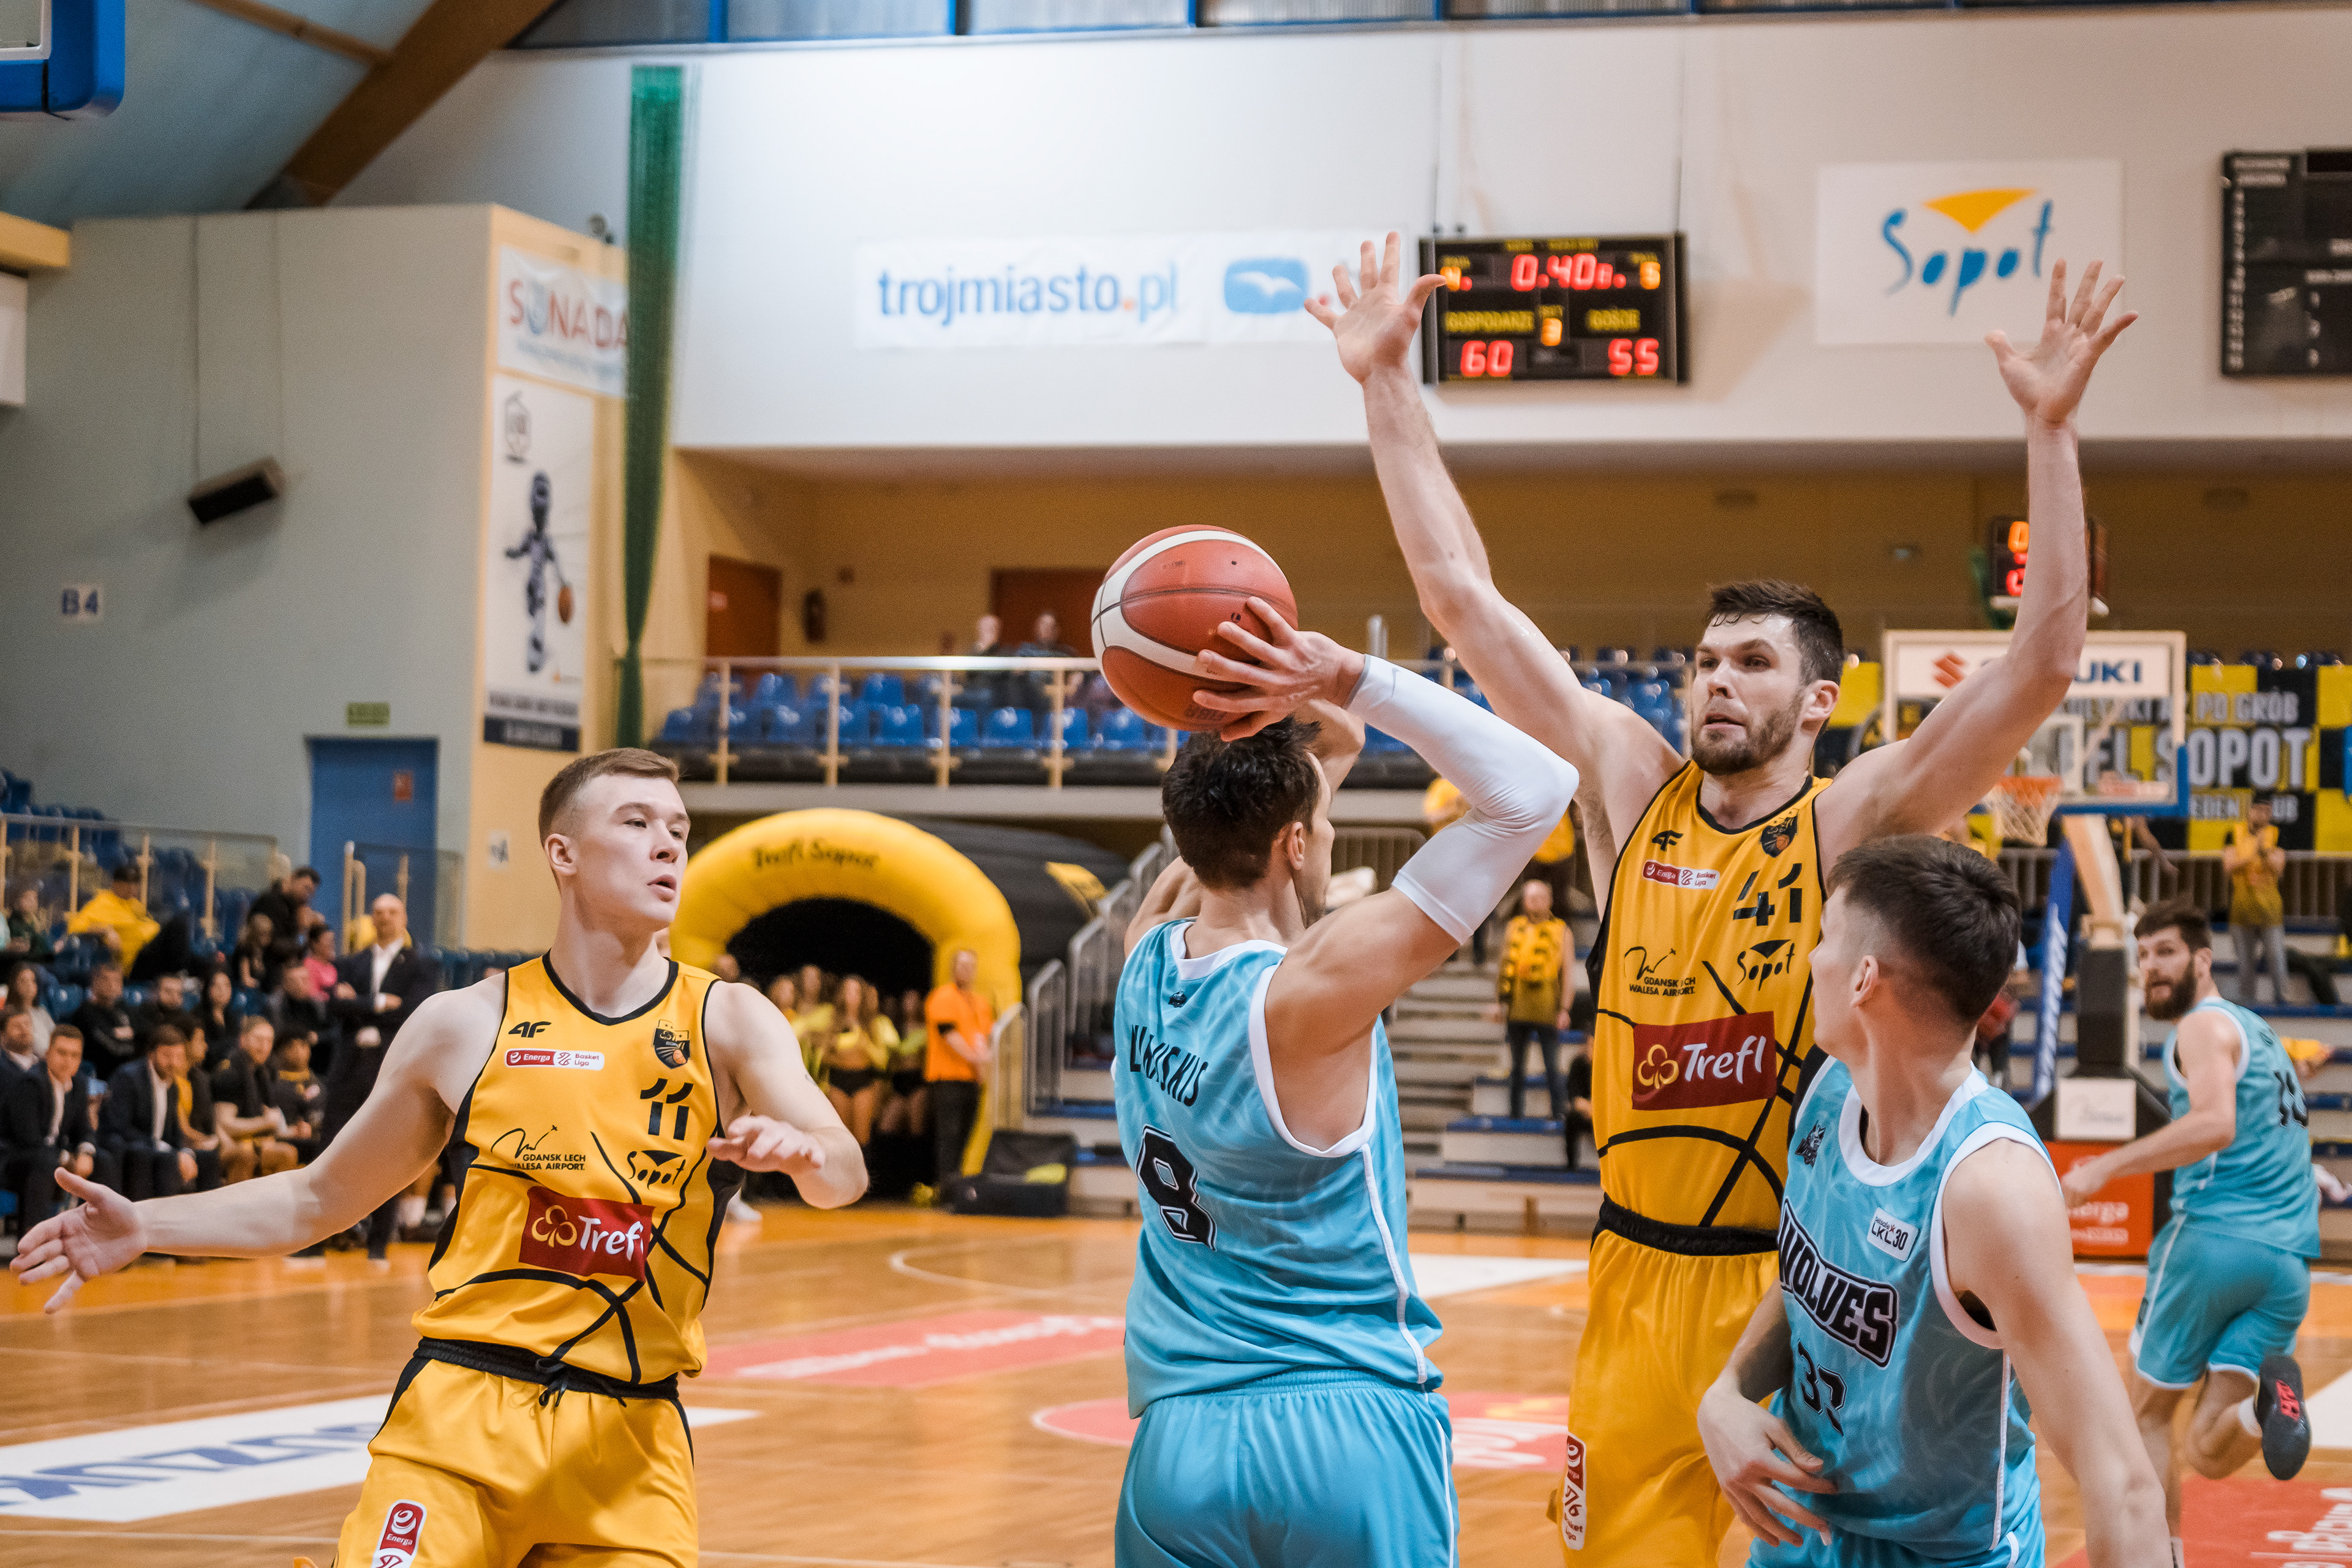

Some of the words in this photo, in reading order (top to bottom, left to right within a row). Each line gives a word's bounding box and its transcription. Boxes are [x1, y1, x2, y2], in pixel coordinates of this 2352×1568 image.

[1882, 198, 2053, 317] Sopot
[878, 258, 1178, 327] trojmiasto.pl
[1460, 340, 1513, 378] 60
[1608, 337, 1660, 376] 55
[61, 588, 100, 616] B4
[2155, 726, 2313, 790] SOPOT
[1733, 862, 1803, 927] 41
[1643, 976, 1679, 988] GDANSK
[1736, 943, 1795, 991] Sopot
[508, 1021, 552, 1038] 4F
[1683, 1035, 1766, 1084] Trefl
[639, 1077, 694, 1140] 11
[627, 1150, 686, 1190] Sopot
[577, 1215, 644, 1261] Tref
[1779, 1203, 1893, 1361] WOLVES
[386, 1533, 413, 1546] Energa
